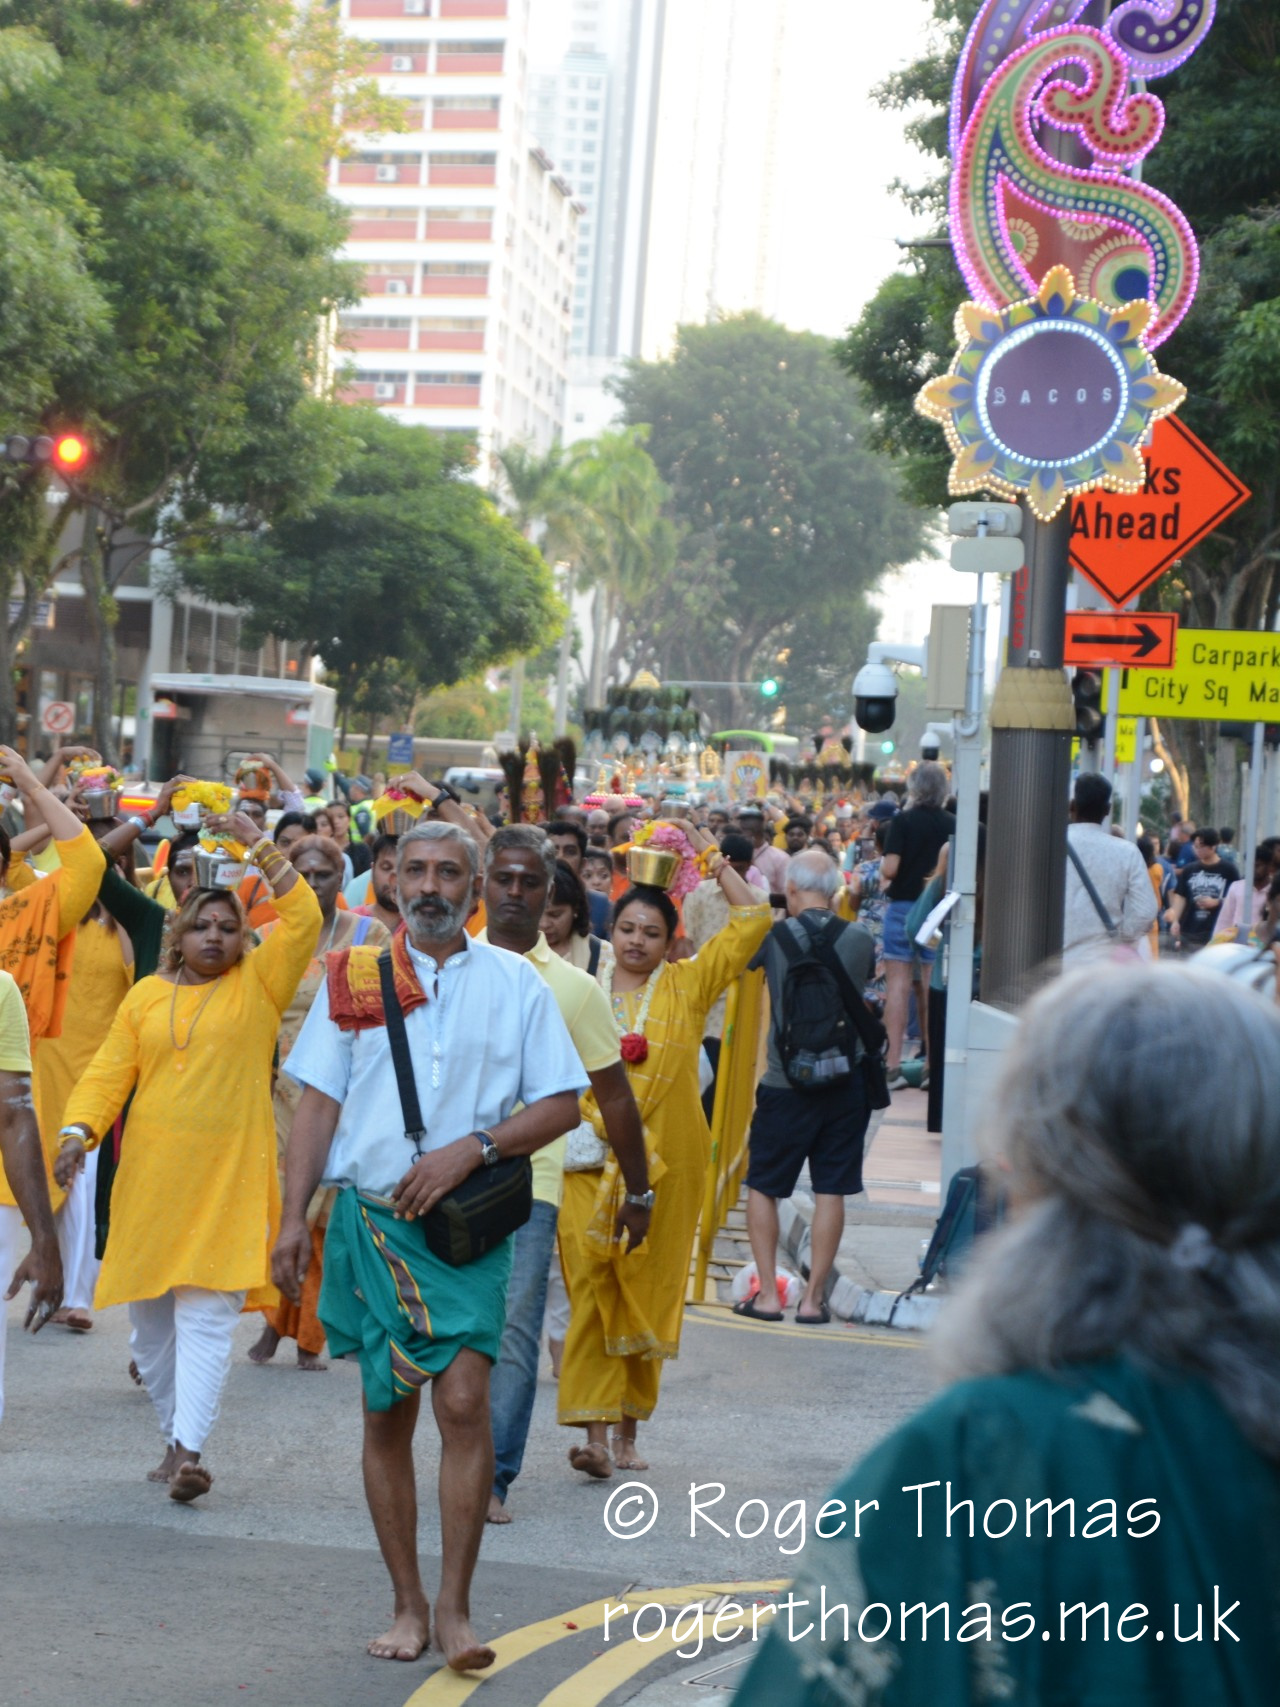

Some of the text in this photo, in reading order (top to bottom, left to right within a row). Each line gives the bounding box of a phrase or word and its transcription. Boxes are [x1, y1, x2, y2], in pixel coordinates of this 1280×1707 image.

[1070, 501, 1181, 540] Ahead
[1192, 643, 1280, 671] Carpark
[1145, 677, 1188, 705] City
[1204, 679, 1228, 707] Sq
